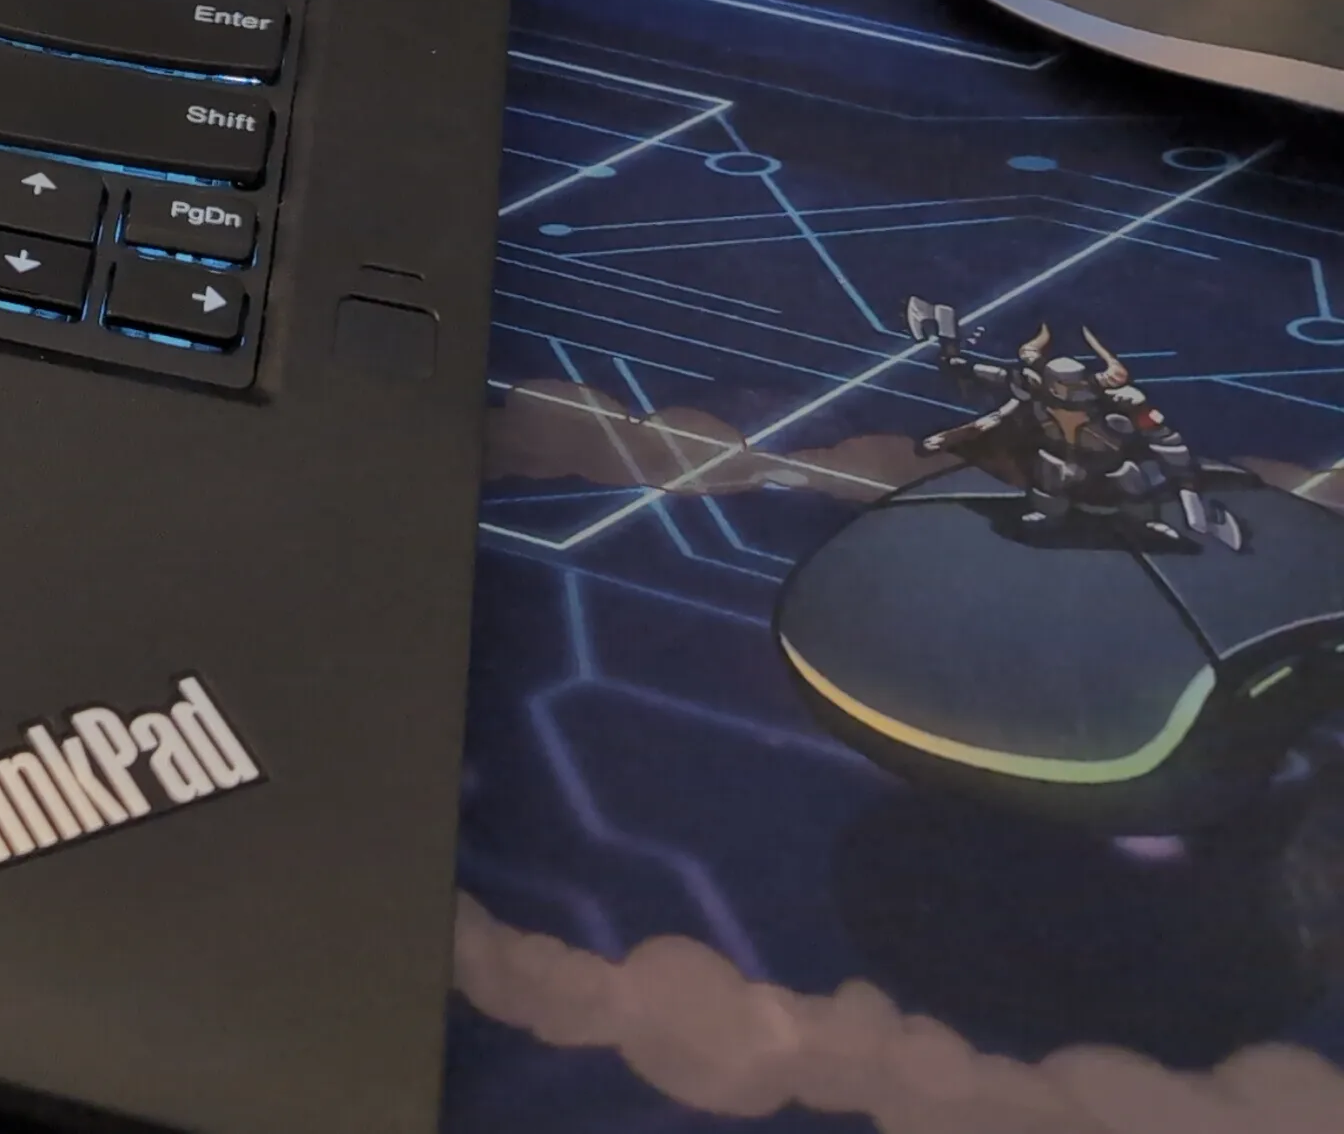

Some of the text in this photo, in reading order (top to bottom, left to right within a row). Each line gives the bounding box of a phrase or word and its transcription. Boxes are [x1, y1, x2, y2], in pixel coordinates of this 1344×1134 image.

[194, 4, 274, 31] Enter
[186, 105, 257, 133] Shift
[170, 201, 243, 228] PgDn
